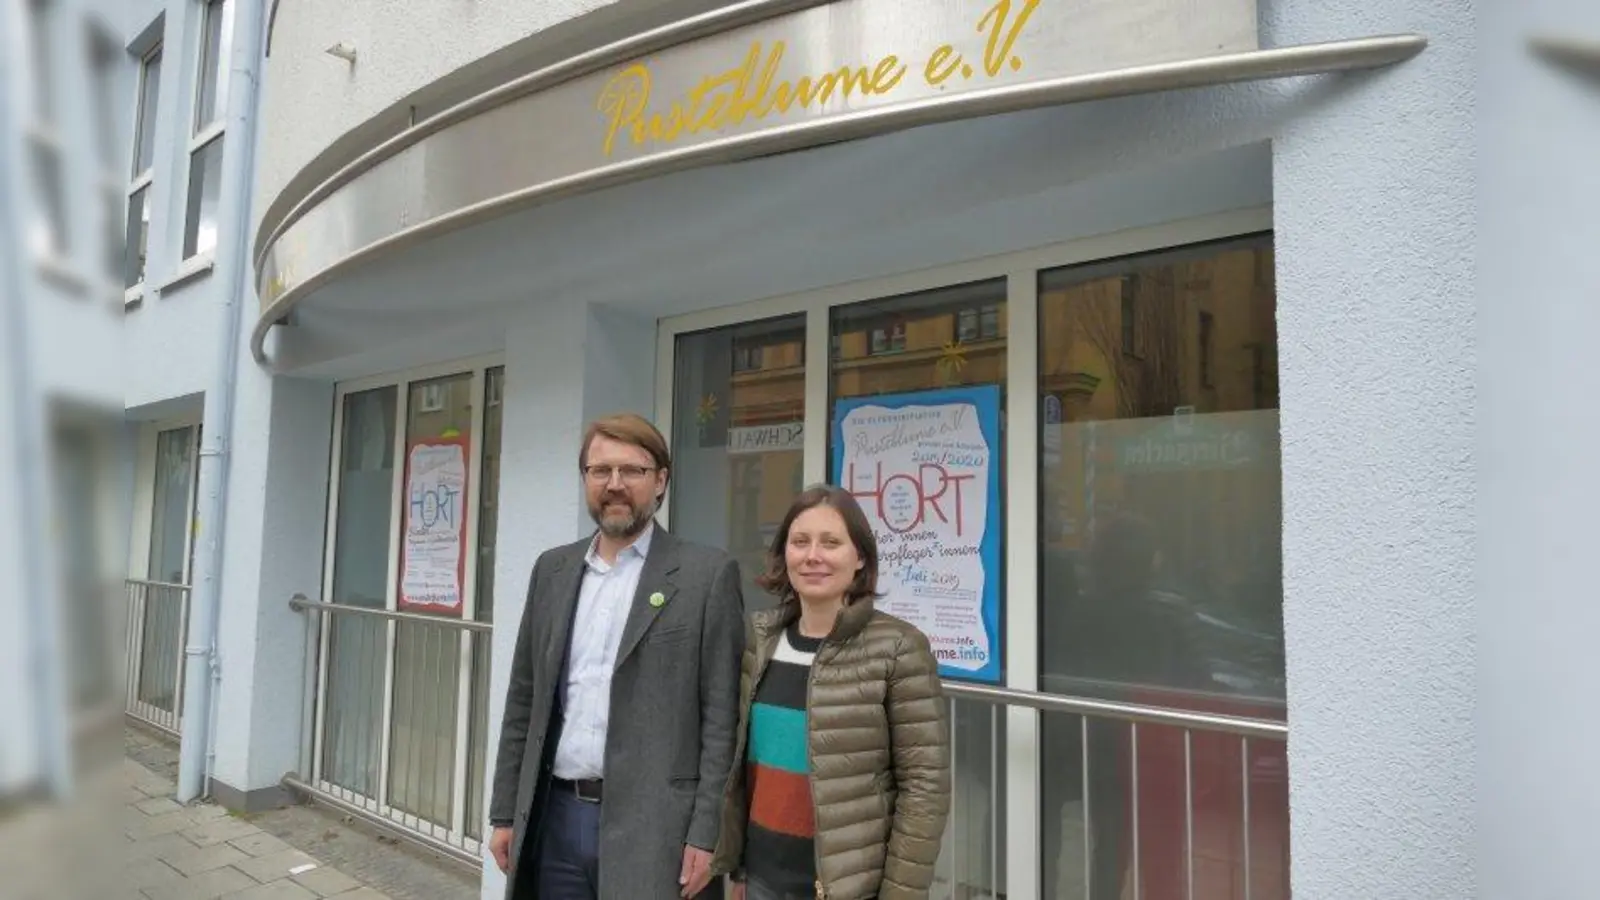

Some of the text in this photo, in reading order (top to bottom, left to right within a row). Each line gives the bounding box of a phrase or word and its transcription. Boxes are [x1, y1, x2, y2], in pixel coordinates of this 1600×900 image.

[598, 41, 908, 157] Pusteblume
[410, 482, 460, 528] HORT
[849, 461, 976, 537] HORT
